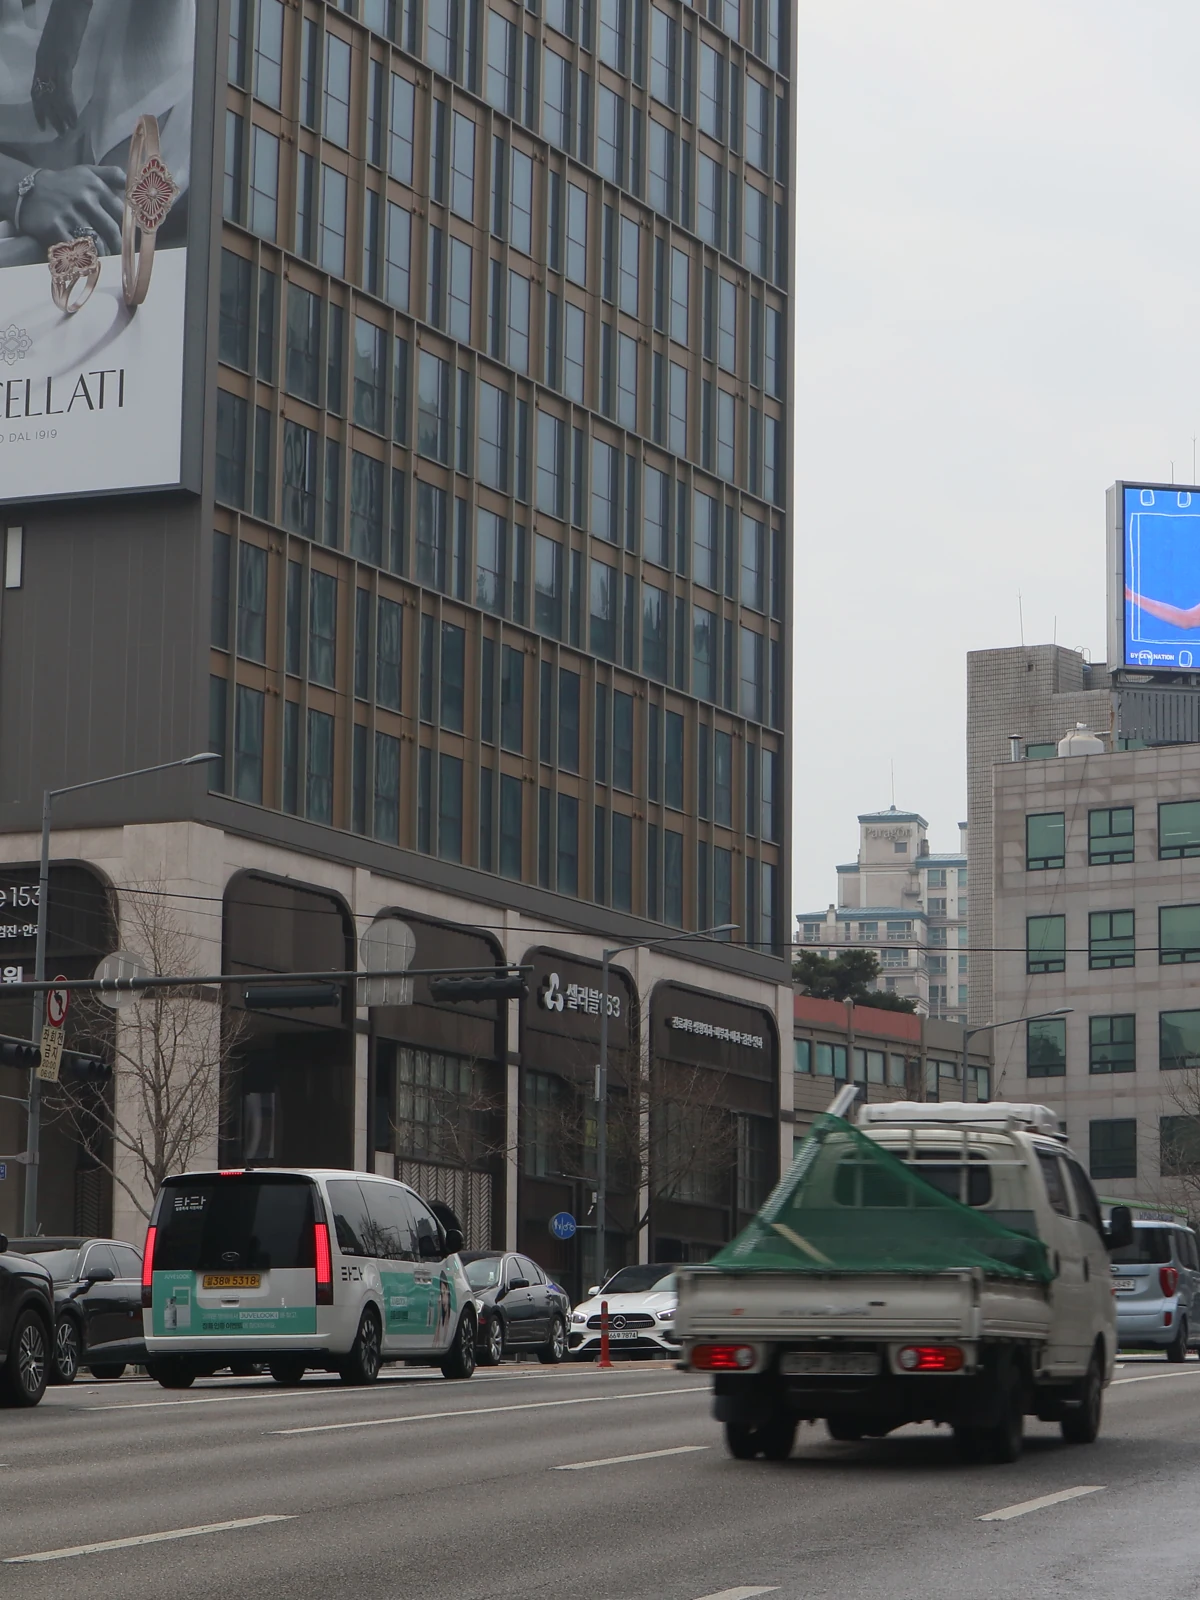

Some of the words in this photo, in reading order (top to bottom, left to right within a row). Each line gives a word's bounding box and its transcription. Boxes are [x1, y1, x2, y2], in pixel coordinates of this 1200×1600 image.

[0, 369, 124, 419] ELLATI
[9, 432, 31, 443] DAL
[35, 429, 58, 440] 1919
[1153, 653, 1175, 661] NATION
[865, 826, 913, 842] Paragon
[0, 966, 23, 984] 원
[43, 1029, 65, 1046] 좌회전
[45, 1044, 59, 1060] 금지
[232, 1275, 257, 1286] 5318
